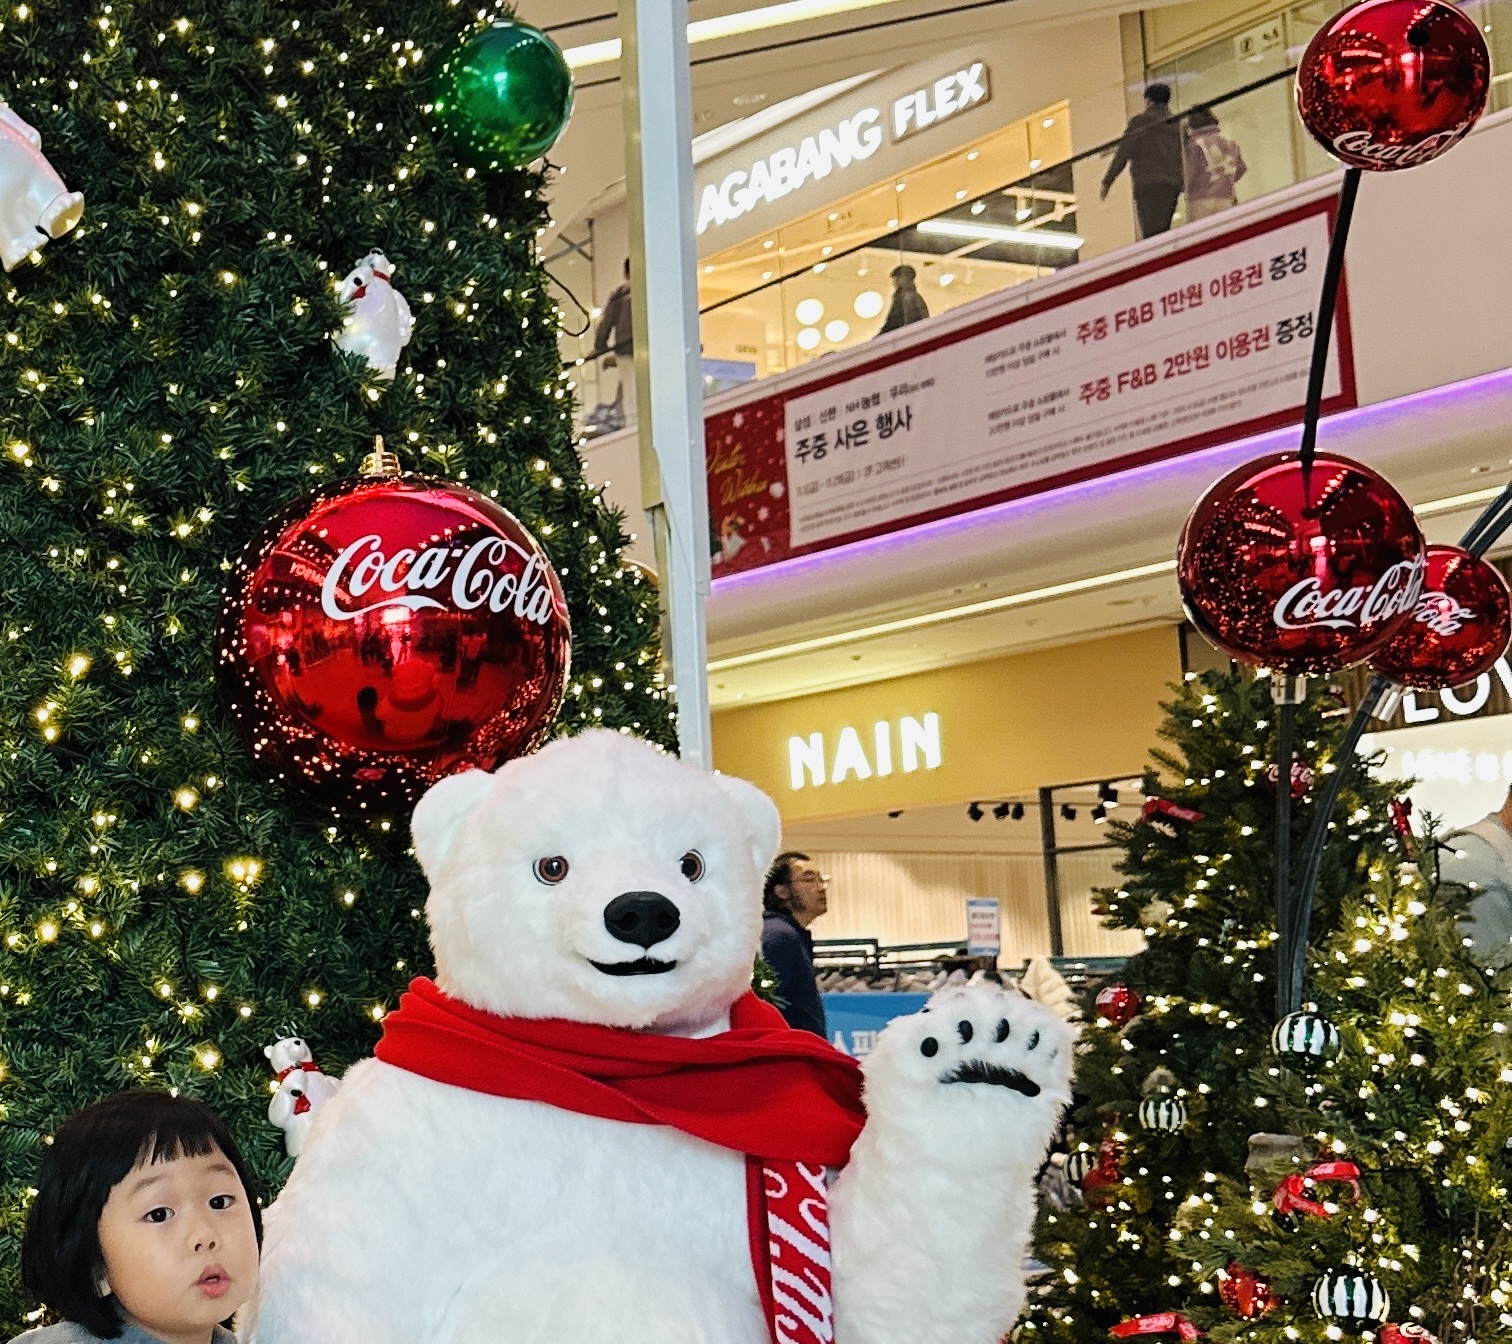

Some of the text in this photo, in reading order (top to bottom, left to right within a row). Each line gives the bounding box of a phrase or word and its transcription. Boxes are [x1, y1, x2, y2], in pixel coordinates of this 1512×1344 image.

[696, 63, 986, 234] AGABANG FLEX
[1076, 247, 1307, 344] 주중 F&B 1만원 이용권 증정
[1078, 312, 1314, 404] 주중 F&B 2만원 이용권 증정
[794, 405, 912, 463] 주중 사은 행사
[321, 535, 558, 625] Coca-Cola
[788, 712, 941, 790] NAIN
